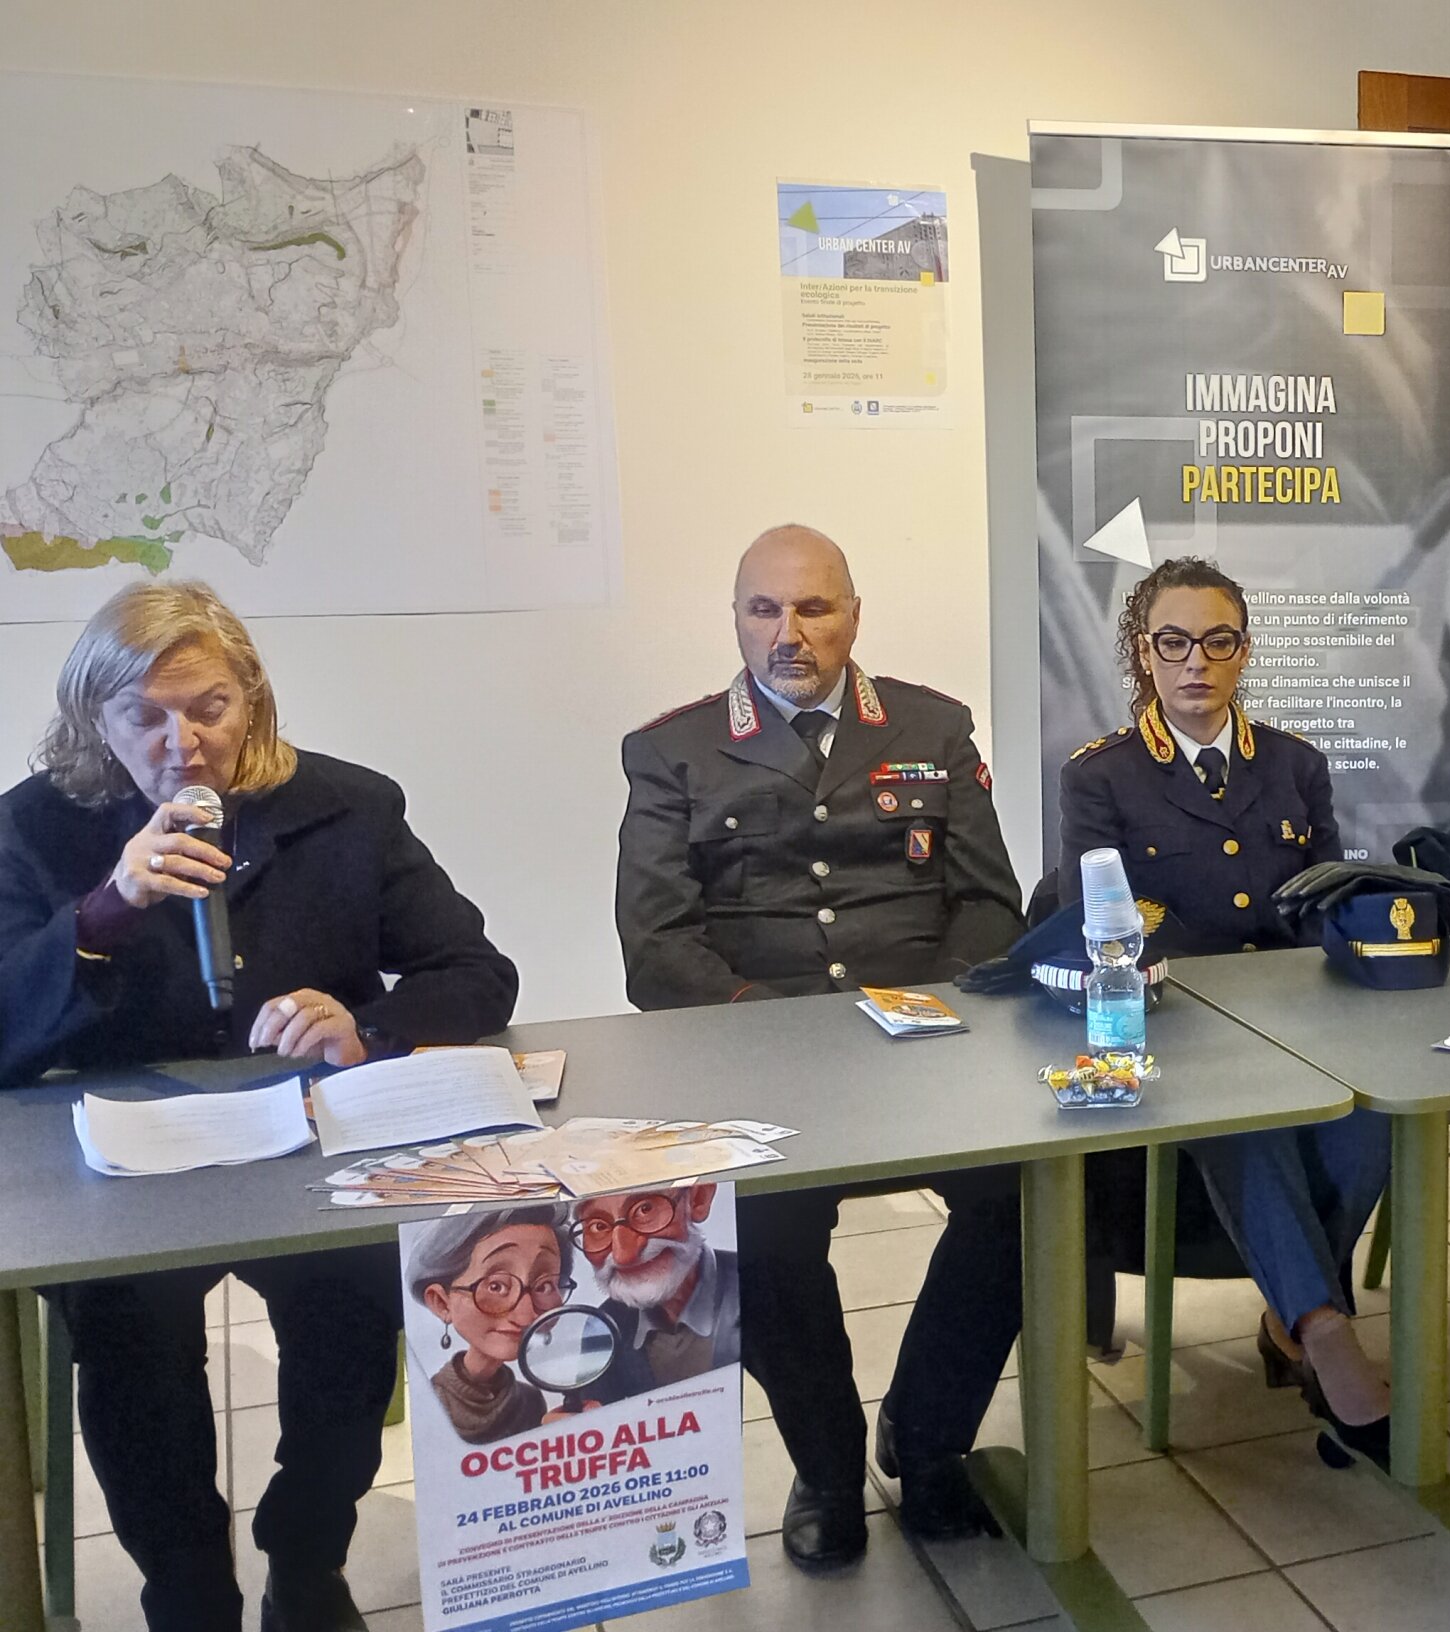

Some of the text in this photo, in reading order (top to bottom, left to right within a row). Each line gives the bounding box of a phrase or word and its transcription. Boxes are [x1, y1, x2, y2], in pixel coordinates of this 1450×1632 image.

[818, 237, 912, 254] URBAN CENTER AV
[800, 290, 840, 299] ecologica
[849, 285, 863, 295] per
[864, 283, 872, 292] la
[874, 284, 918, 294] transizione
[1185, 373, 1337, 413] IMMAGINA
[1199, 420, 1323, 458] PROPONI
[1182, 465, 1341, 503] PARTECIPA
[1242, 591, 1410, 605] vellino nasce dalla volontà
[1264, 615, 1280, 625] un
[1284, 614, 1319, 628] punto
[1323, 613, 1335, 625] di
[1338, 613, 1408, 625] riferimento
[1303, 634, 1373, 646] sostenibile
[1375, 634, 1395, 646] del
[1260, 655, 1320, 667] territorio.
[1271, 676, 1329, 688] dinamica
[1332, 676, 1356, 688] che
[1358, 676, 1400, 688] unisce
[1403, 675, 1411, 688] il
[1243, 696, 1402, 711] per facilitare l'incontro, la
[1270, 717, 1278, 729] il
[1281, 717, 1334, 731] progetto
[1337, 718, 1355, 729] tra
[1320, 737, 1331, 749] le
[1334, 737, 1392, 751] cittadine,
[1395, 737, 1407, 749] le
[1335, 757, 1380, 770] scuole.
[460, 1411, 701, 1478] OCCHIO ALLA
[516, 1447, 652, 1494] TRUFFA
[457, 1464, 709, 1528] 24 FEBBRAIO 2026 ORE 11:00
[498, 1487, 672, 1534] AL COMUNE DI AVELLINO
[451, 1574, 514, 1594] COMMISSARIO
[516, 1556, 586, 1579] STRAORDINARIO
[466, 1565, 511, 1582] PRESENTE
[442, 1587, 498, 1605] PREFETTIZIO
[500, 1583, 517, 1592] DEL
[518, 1573, 556, 1587] COMUNE
[567, 1560, 608, 1576] AVELLINO
[442, 1585, 541, 1615] GIULIANA PERROTTA
